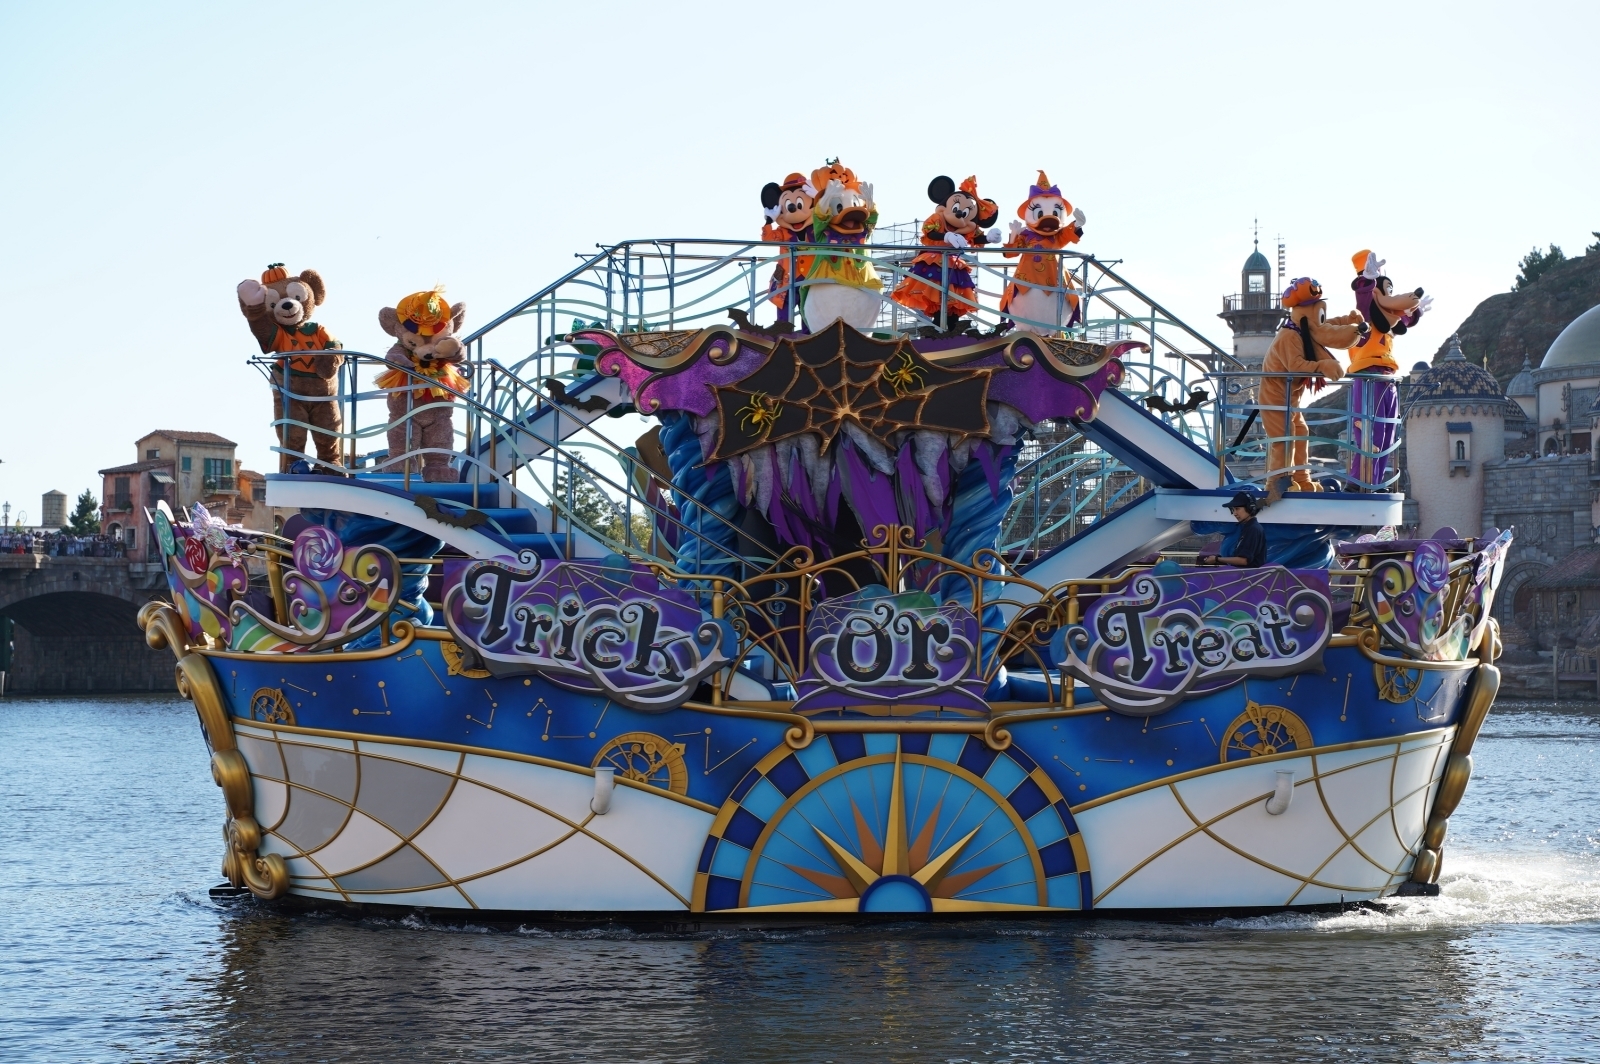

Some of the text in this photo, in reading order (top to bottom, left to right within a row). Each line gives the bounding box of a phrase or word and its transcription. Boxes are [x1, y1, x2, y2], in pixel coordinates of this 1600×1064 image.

[464, 548, 1298, 683] Trick Or Treat
